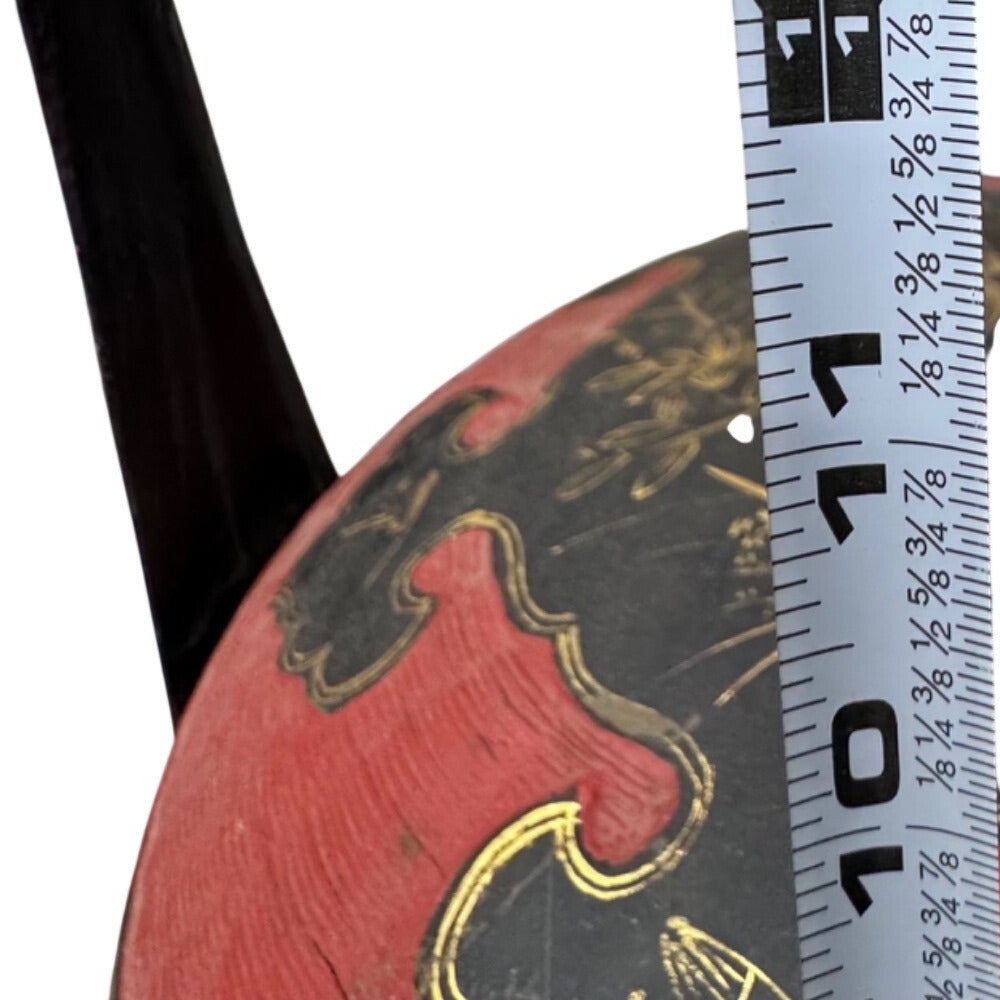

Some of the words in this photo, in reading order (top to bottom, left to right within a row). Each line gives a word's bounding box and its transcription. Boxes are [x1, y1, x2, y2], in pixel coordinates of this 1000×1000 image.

[886, 13, 934, 59] 7/8
[888, 73, 934, 120] 3/4
[890, 133, 937, 178] 5/8
[892, 193, 938, 236] 1/2
[894, 251, 941, 295] 3/8
[897, 307, 942, 348] 1/4
[899, 357, 944, 397] 1/8
[809, 332, 887, 546] 11
[903, 468, 947, 508] 7/8
[905, 516, 948, 557] 3/4
[907, 568, 951, 607] 5/8
[909, 617, 952, 655] 1/2
[911, 666, 954, 704] 3/8
[913, 713, 954, 751] 1/4
[915, 755, 956, 793] 1/8
[832, 699, 904, 918] 10
[919, 850, 960, 886] 7/8
[921, 890, 961, 926] 3/4
[922, 934, 962, 969] 5/8
